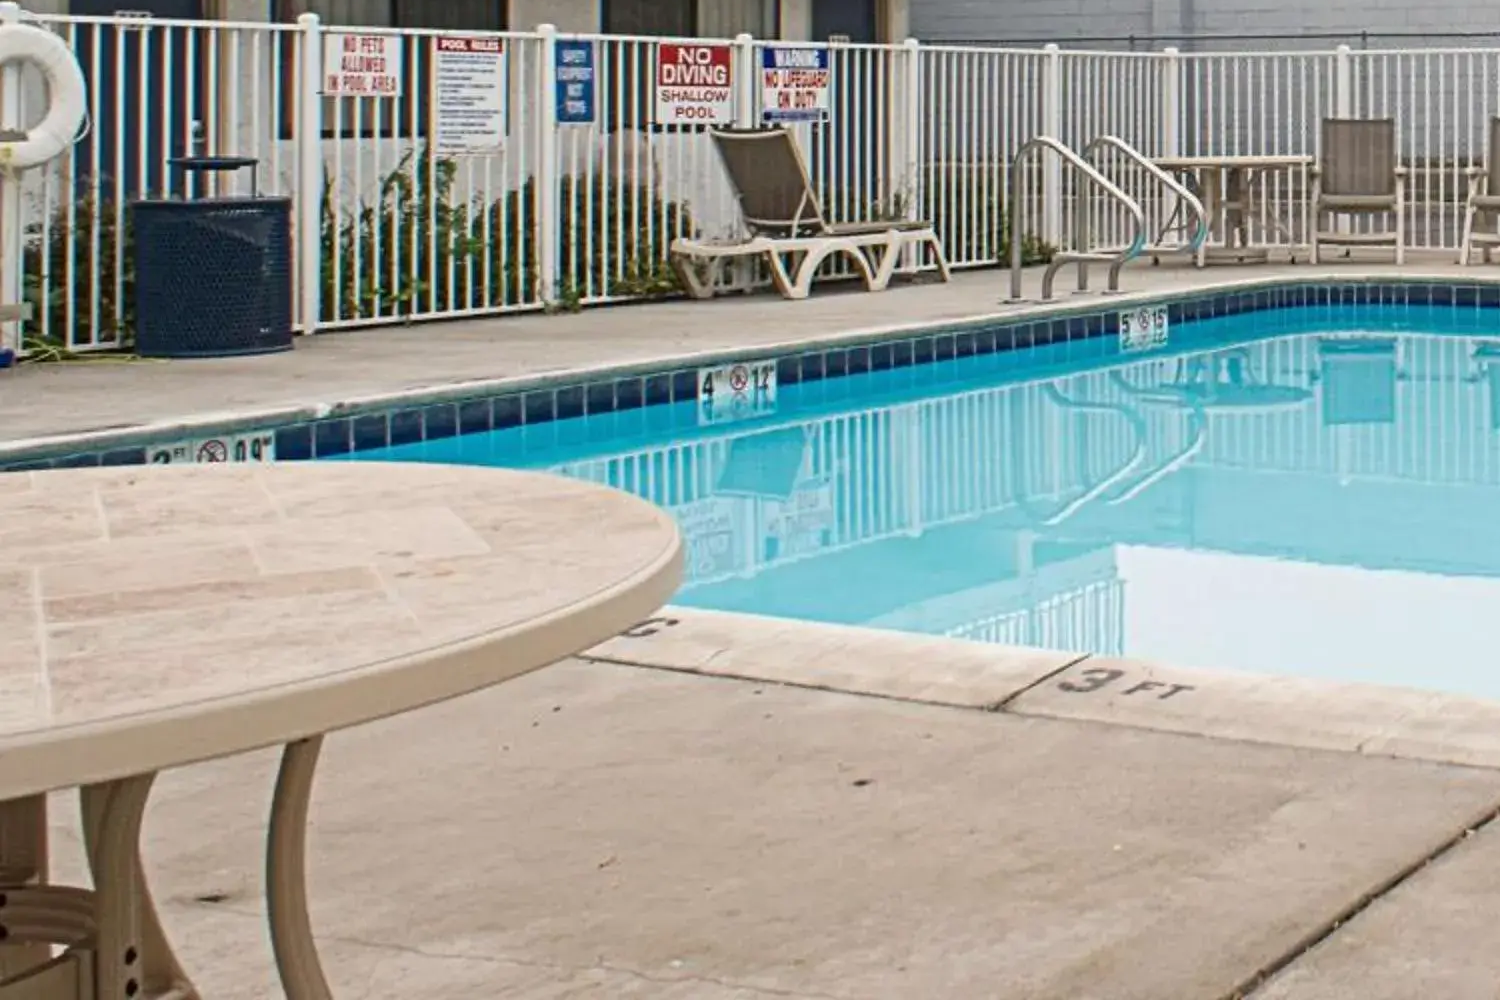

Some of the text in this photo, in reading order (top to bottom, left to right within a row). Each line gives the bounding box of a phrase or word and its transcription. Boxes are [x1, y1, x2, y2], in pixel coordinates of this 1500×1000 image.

[344, 35, 385, 53] NO PETS
[441, 39, 467, 51] POOL
[342, 55, 386, 73] ALLOWED
[677, 47, 712, 65] NO
[774, 48, 820, 67] WARNING
[327, 74, 396, 92] IN POOL AREA
[662, 63, 728, 86] DIVING
[765, 71, 829, 88] NO LIFEGUARD
[661, 89, 729, 103] SHALLOW
[778, 91, 817, 108] ON DUTY
[675, 105, 716, 118] POOL
[702, 371, 714, 396] 4
[1056, 667, 1196, 700] 3 FT
